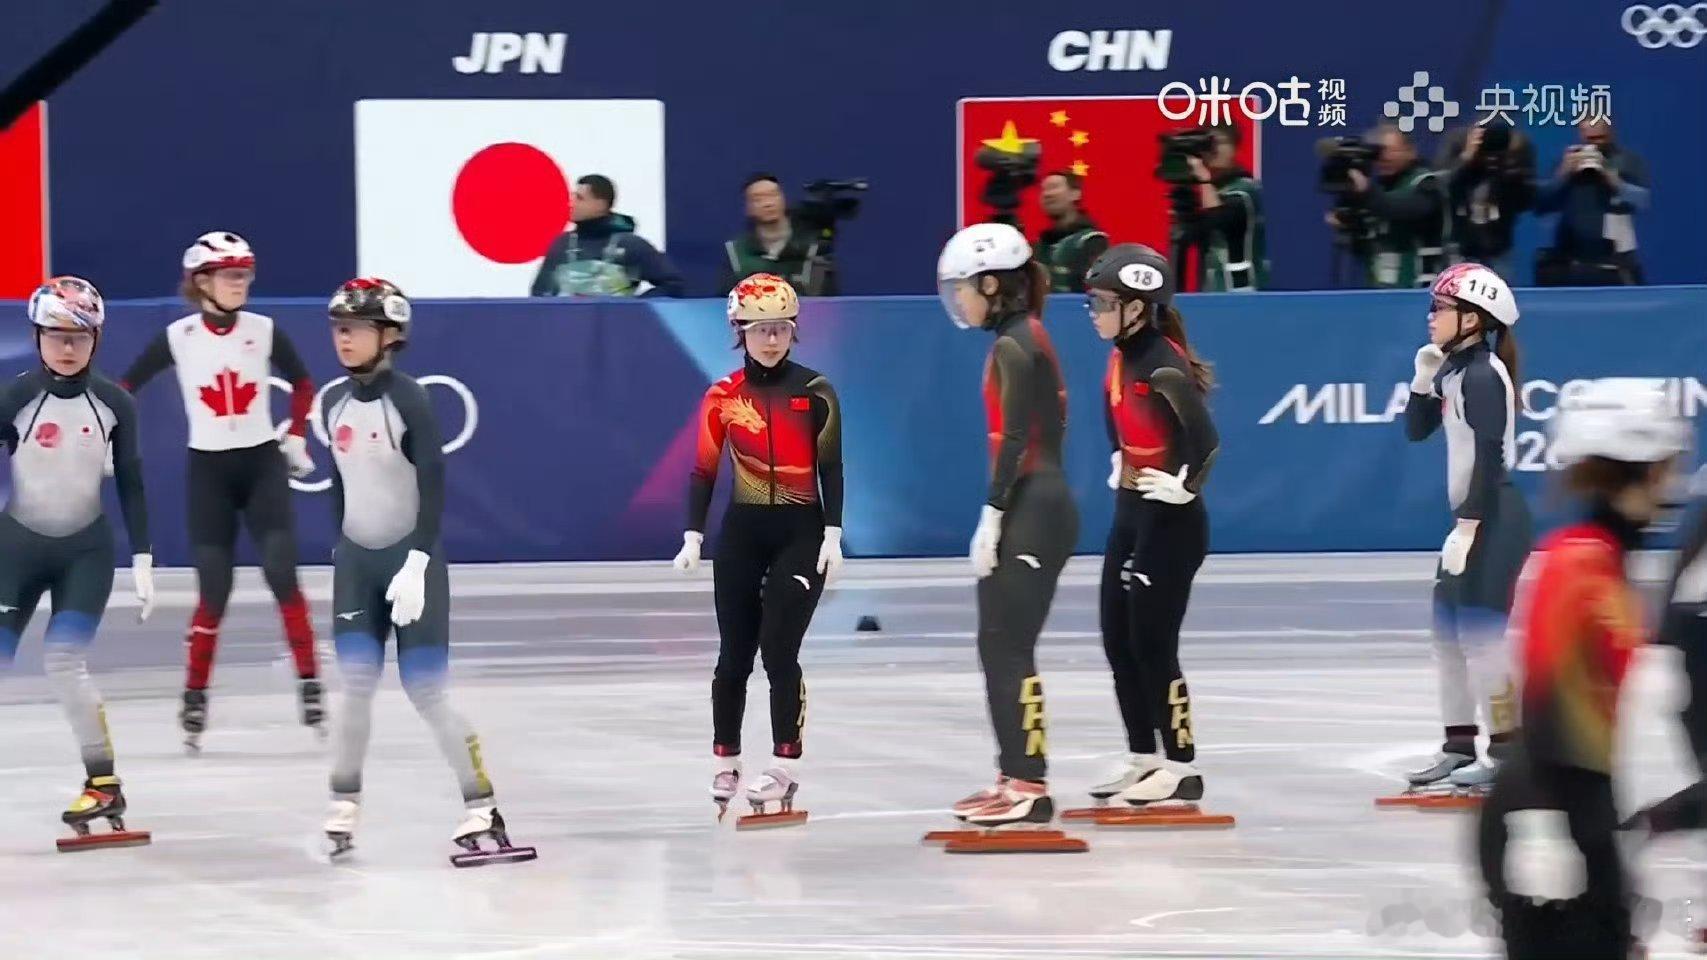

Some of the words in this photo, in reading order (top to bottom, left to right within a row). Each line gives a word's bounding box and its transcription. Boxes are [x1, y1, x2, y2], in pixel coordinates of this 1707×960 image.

[452, 32, 568, 74] JPN
[1047, 29, 1173, 72] CHN
[1132, 269, 1154, 287] 18
[1468, 279, 1498, 300] 113
[1257, 383, 1412, 424] MILA
